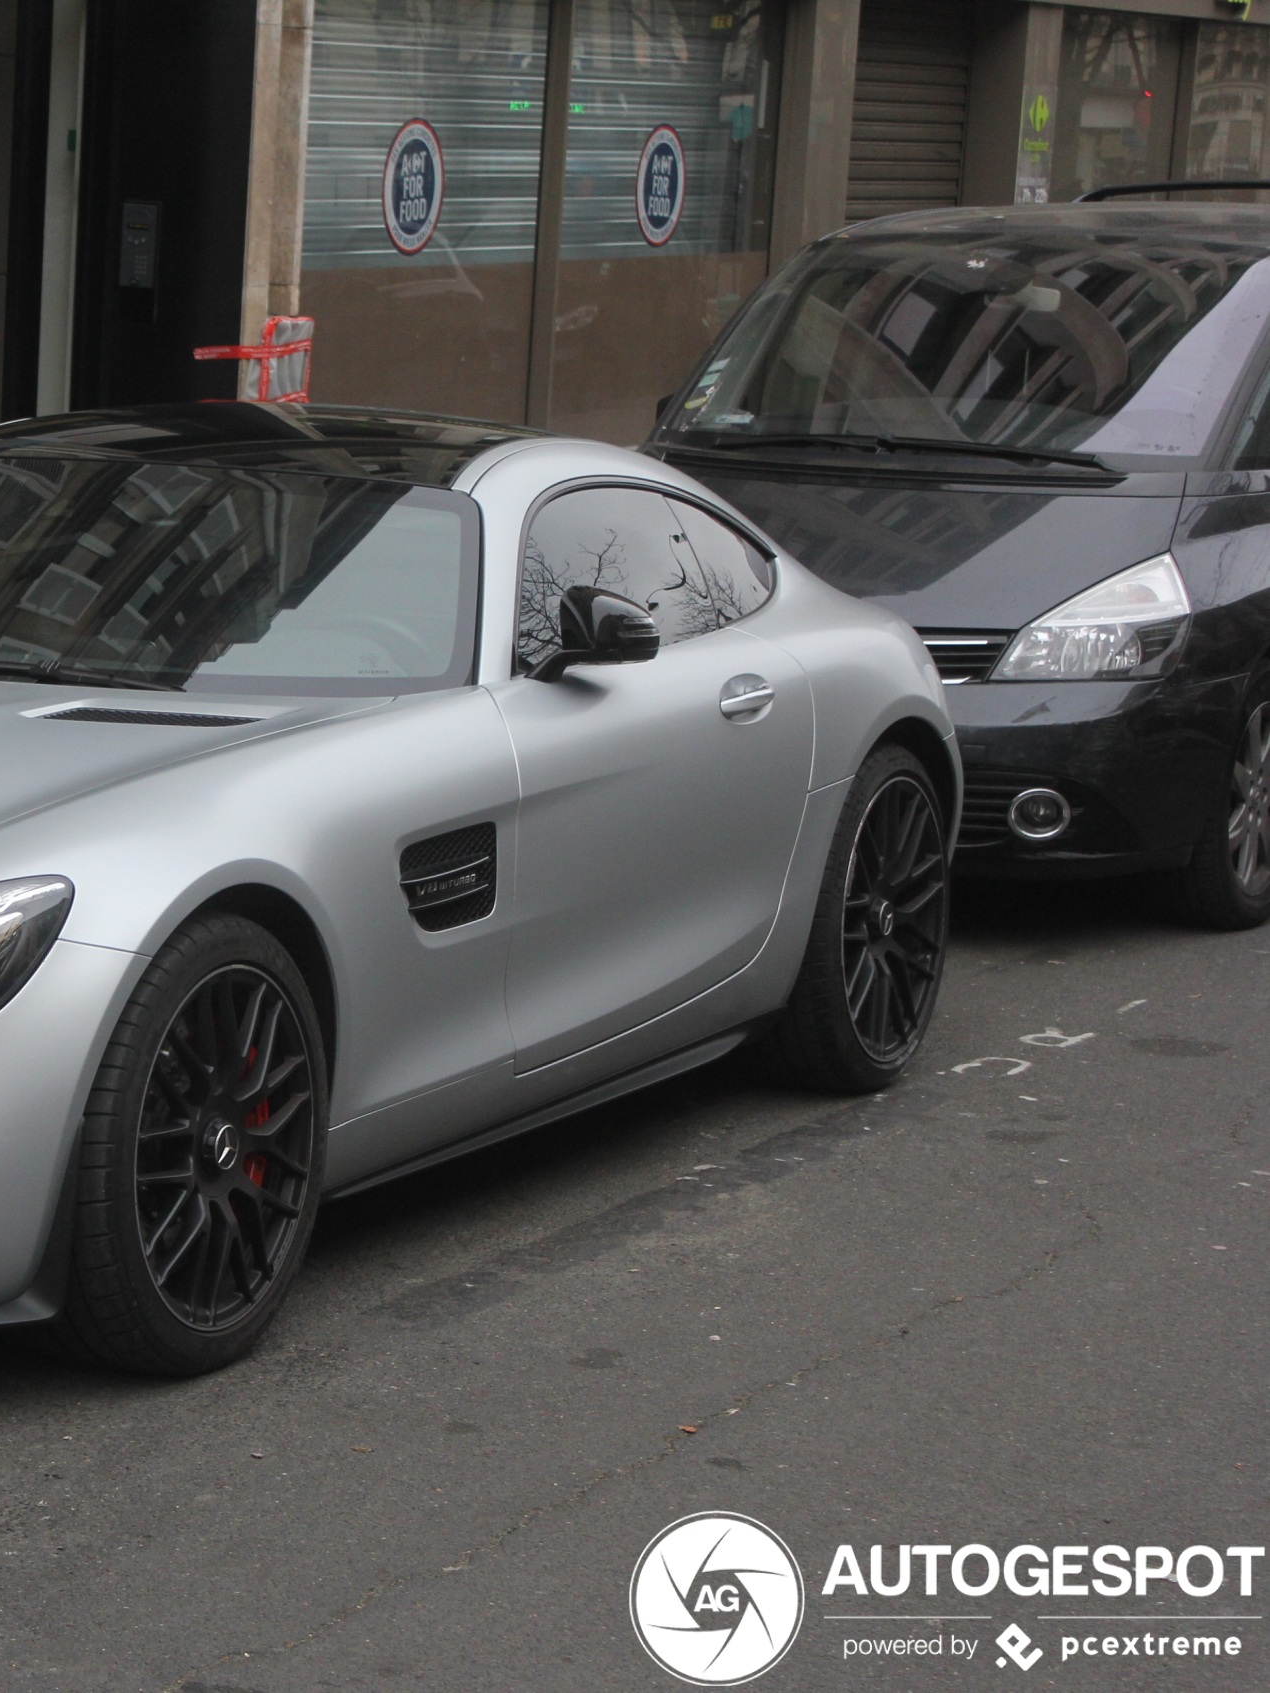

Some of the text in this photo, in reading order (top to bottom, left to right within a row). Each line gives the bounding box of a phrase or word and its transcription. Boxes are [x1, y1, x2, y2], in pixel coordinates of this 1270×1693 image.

[403, 175, 424, 200] FOR
[652, 174, 670, 196] FOR
[400, 198, 428, 224] FOOD
[648, 196, 670, 218] FOOD
